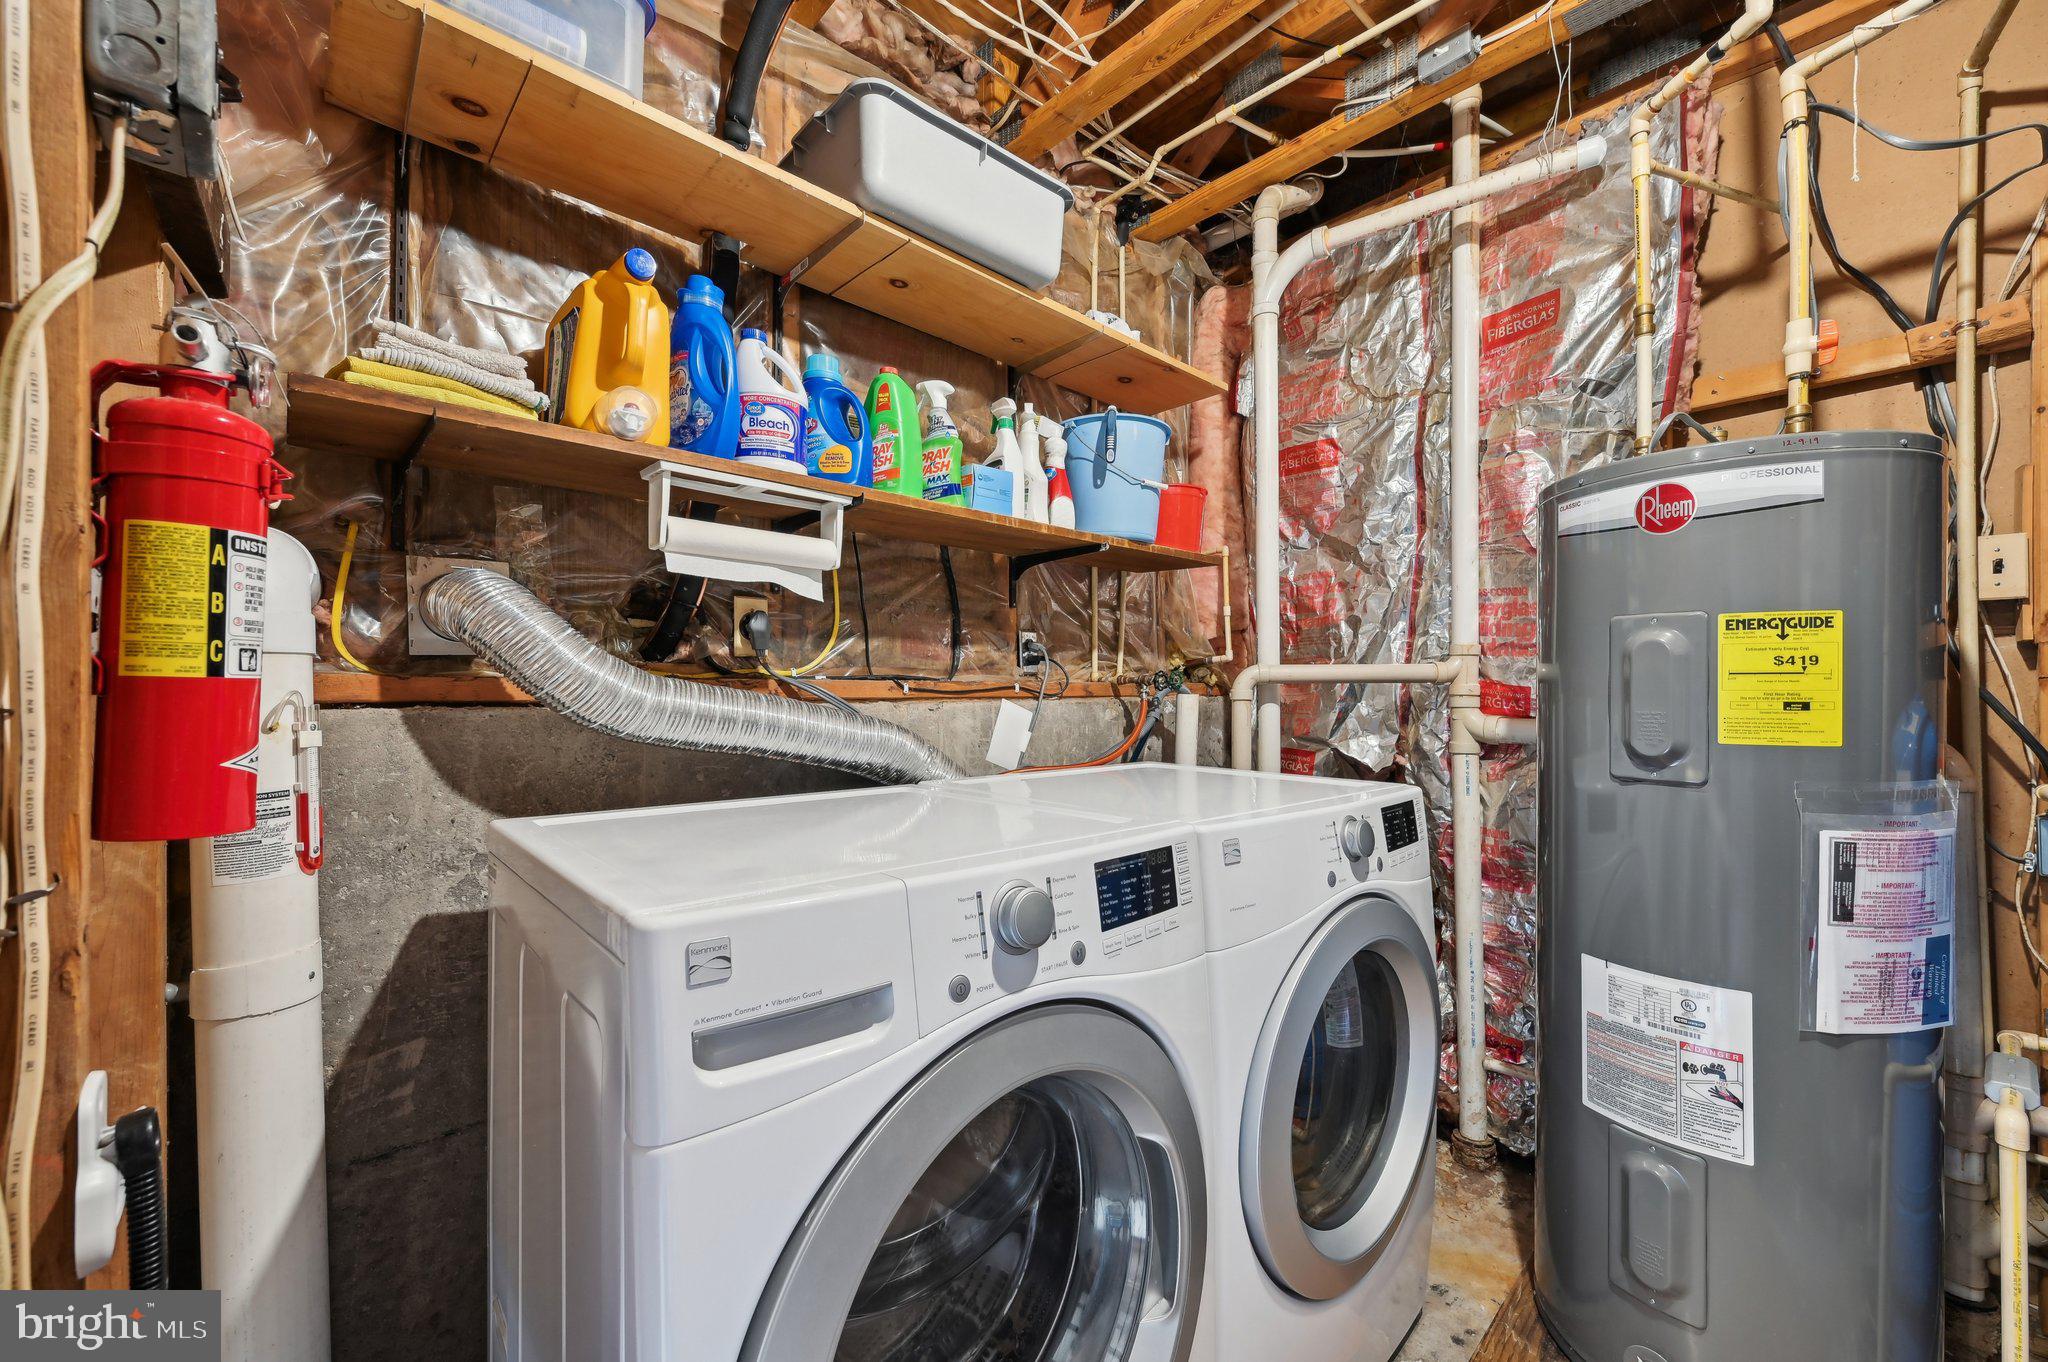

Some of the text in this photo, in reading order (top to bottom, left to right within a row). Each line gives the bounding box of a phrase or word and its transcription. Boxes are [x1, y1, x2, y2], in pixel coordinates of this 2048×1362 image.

[1487, 307, 1555, 343] FIBERGLAS
[749, 416, 790, 432] Bleach
[873, 441, 894, 456] RAY
[922, 446, 953, 461] PRAY
[873, 454, 894, 469] ASH
[922, 459, 951, 478] ASH
[926, 474, 949, 484] MAX
[1720, 465, 1820, 482] PROFESSIONAL
[1559, 501, 1581, 513] CLASSIC
[1641, 486, 1694, 527] Rheem
[211, 543, 226, 566] A
[211, 592, 224, 614] B
[1725, 615, 1835, 634] ENERGYGUIDE
[209, 639, 223, 663] C
[1773, 655, 1819, 666] $419
[25, 669, 34, 692] TYPE
[27, 698, 35, 715] NM
[1484, 695, 1525, 711] RGLAS
[27, 757, 35, 783] WITH
[268, 790, 290, 799] SYSTEM
[25, 788, 35, 832] GROUND
[1884, 820, 1919, 828] IMPORTANT
[957, 894, 975, 903] Normal
[964, 913, 977, 921] Bulky
[951, 933, 979, 943] Heavy Duty
[30, 941, 40, 964] 600
[690, 943, 729, 956] Kenmore
[964, 952, 981, 960] Whites
[1933, 966, 1941, 996] Limited
[1939, 953, 1948, 995] Certificate
[30, 969, 39, 1000] VOLTS
[976, 983, 994, 993] POWER
[700, 988, 823, 1025] Kenmore Connect Vibration Guard
[27, 1014, 38, 1047] CERRO
[1694, 1047, 1740, 1061] DANGER
